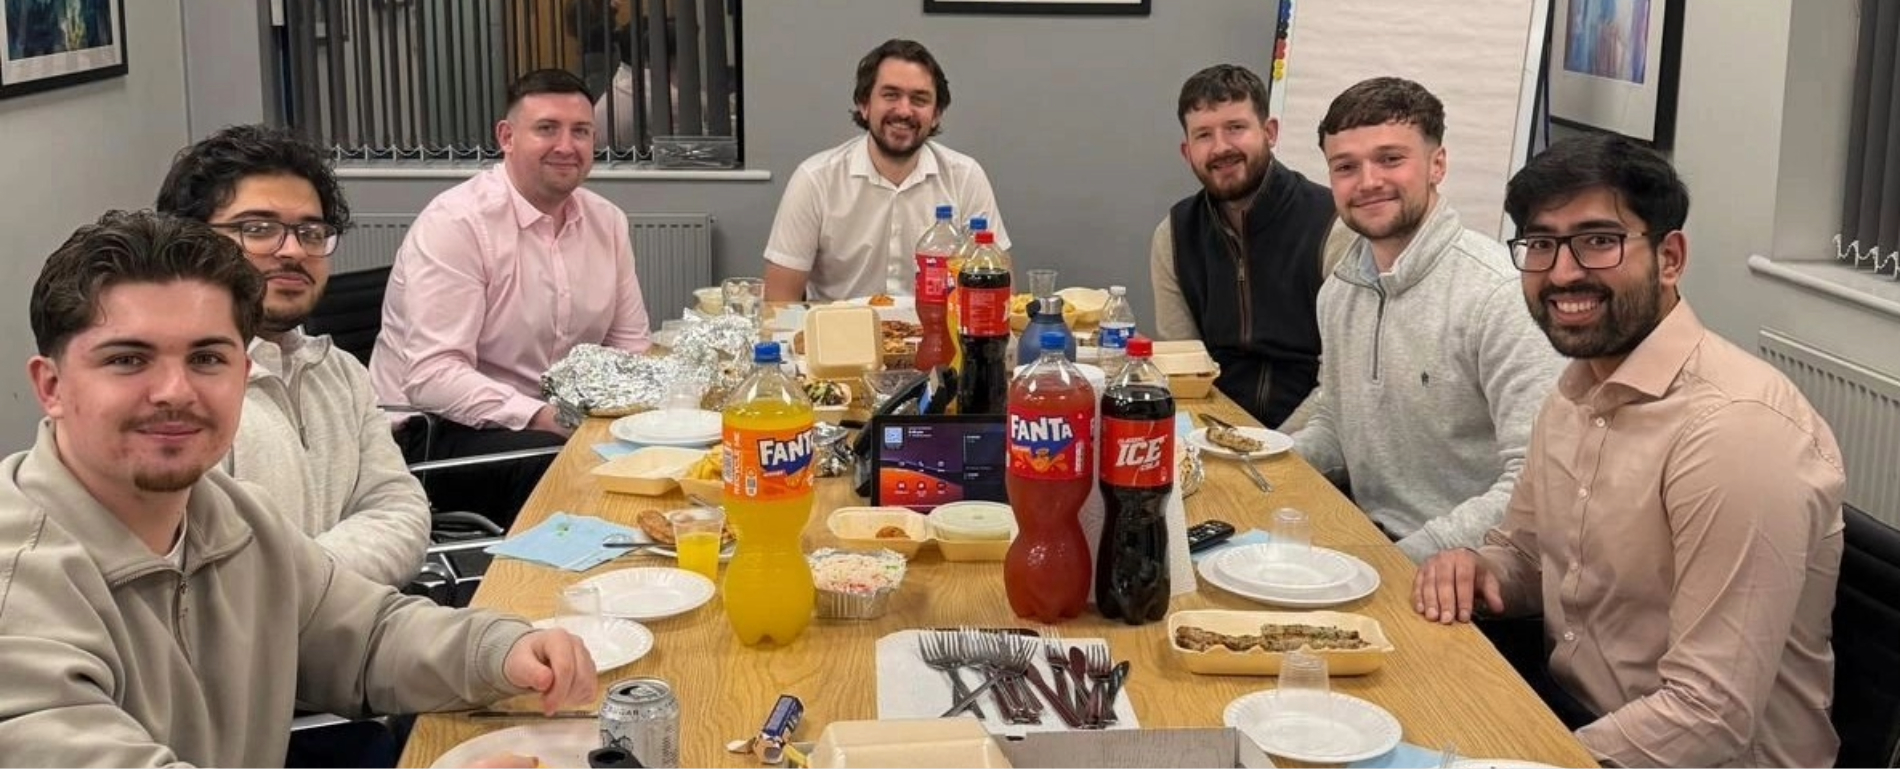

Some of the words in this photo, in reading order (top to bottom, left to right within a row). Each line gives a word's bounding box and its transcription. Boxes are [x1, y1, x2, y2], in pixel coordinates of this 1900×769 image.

[1011, 414, 1073, 442] FANTA
[759, 429, 813, 466] FANT
[1115, 436, 1166, 467] ICE
